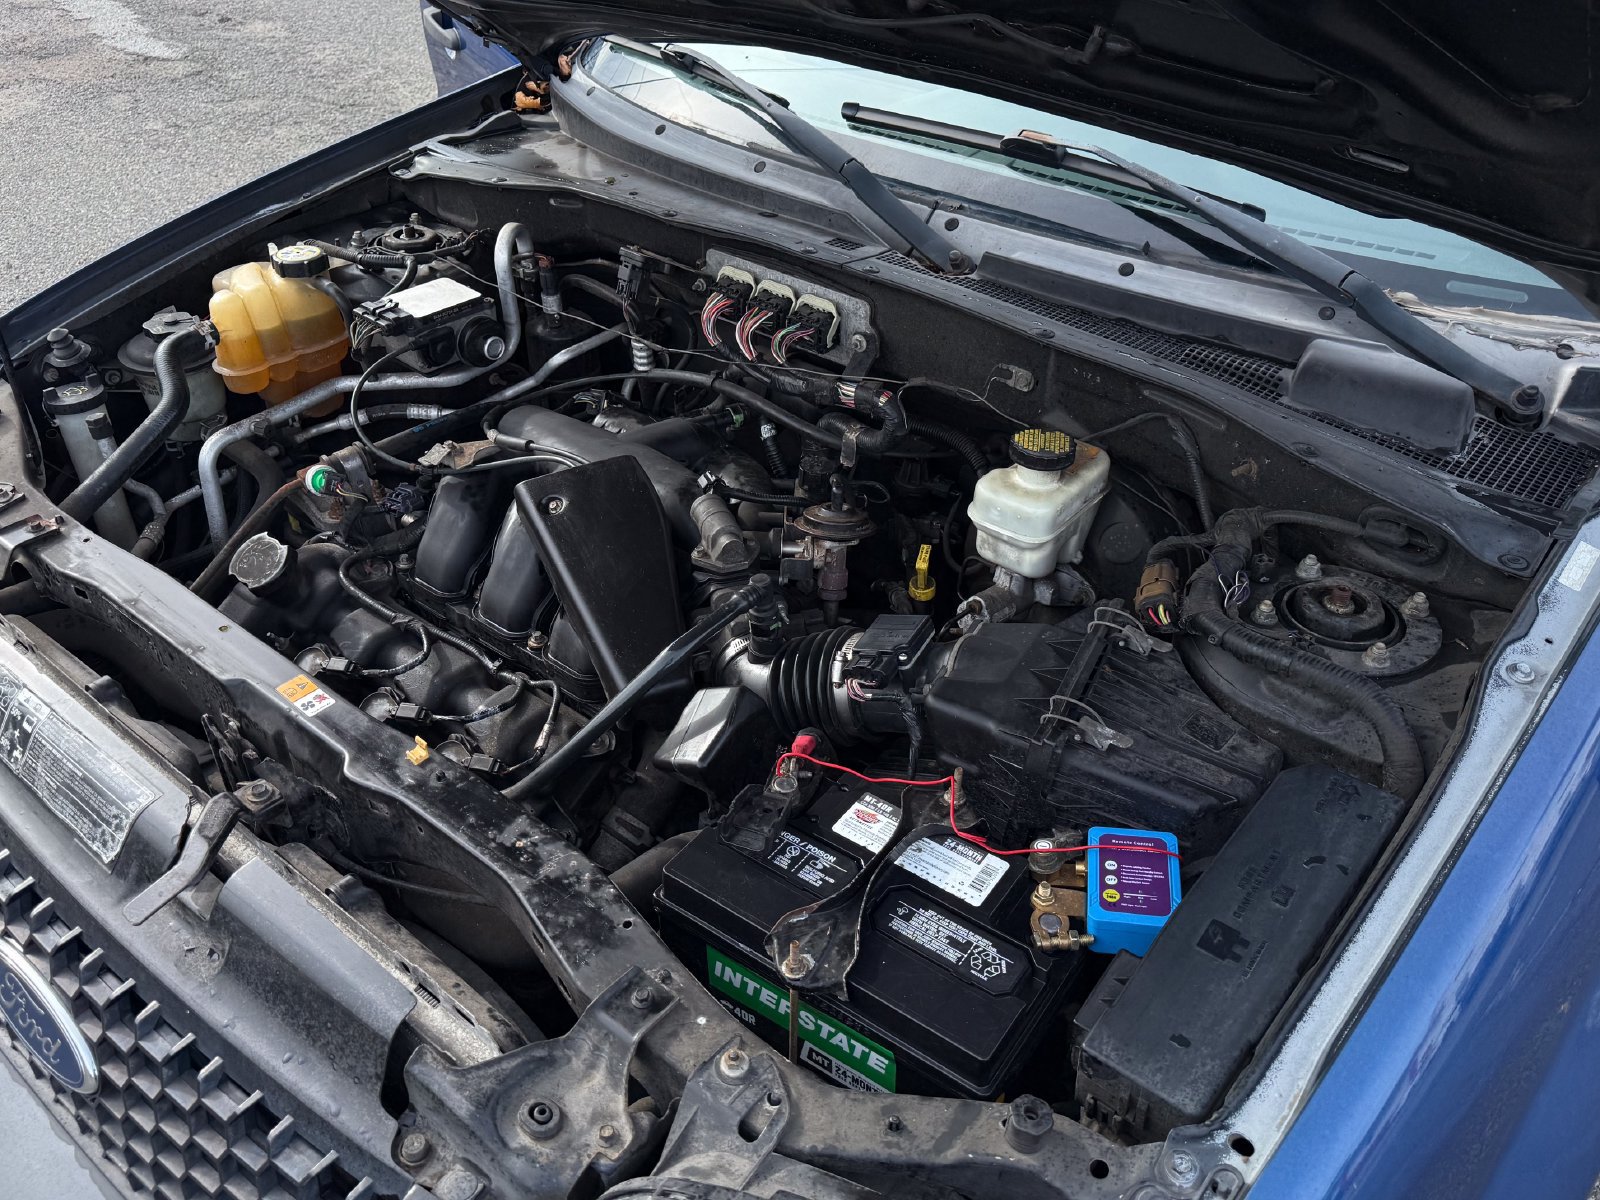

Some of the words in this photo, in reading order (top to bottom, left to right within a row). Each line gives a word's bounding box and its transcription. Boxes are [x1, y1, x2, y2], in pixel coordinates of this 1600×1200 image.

[863, 794, 894, 813] MT-40R
[806, 844, 837, 863] POISON
[943, 838, 983, 860] 24-MONTH
[0, 972, 62, 1064] Ford
[714, 960, 889, 1075] INTERSTATE
[812, 1052, 831, 1068] MT
[834, 1065, 882, 1092] 24-MONT
